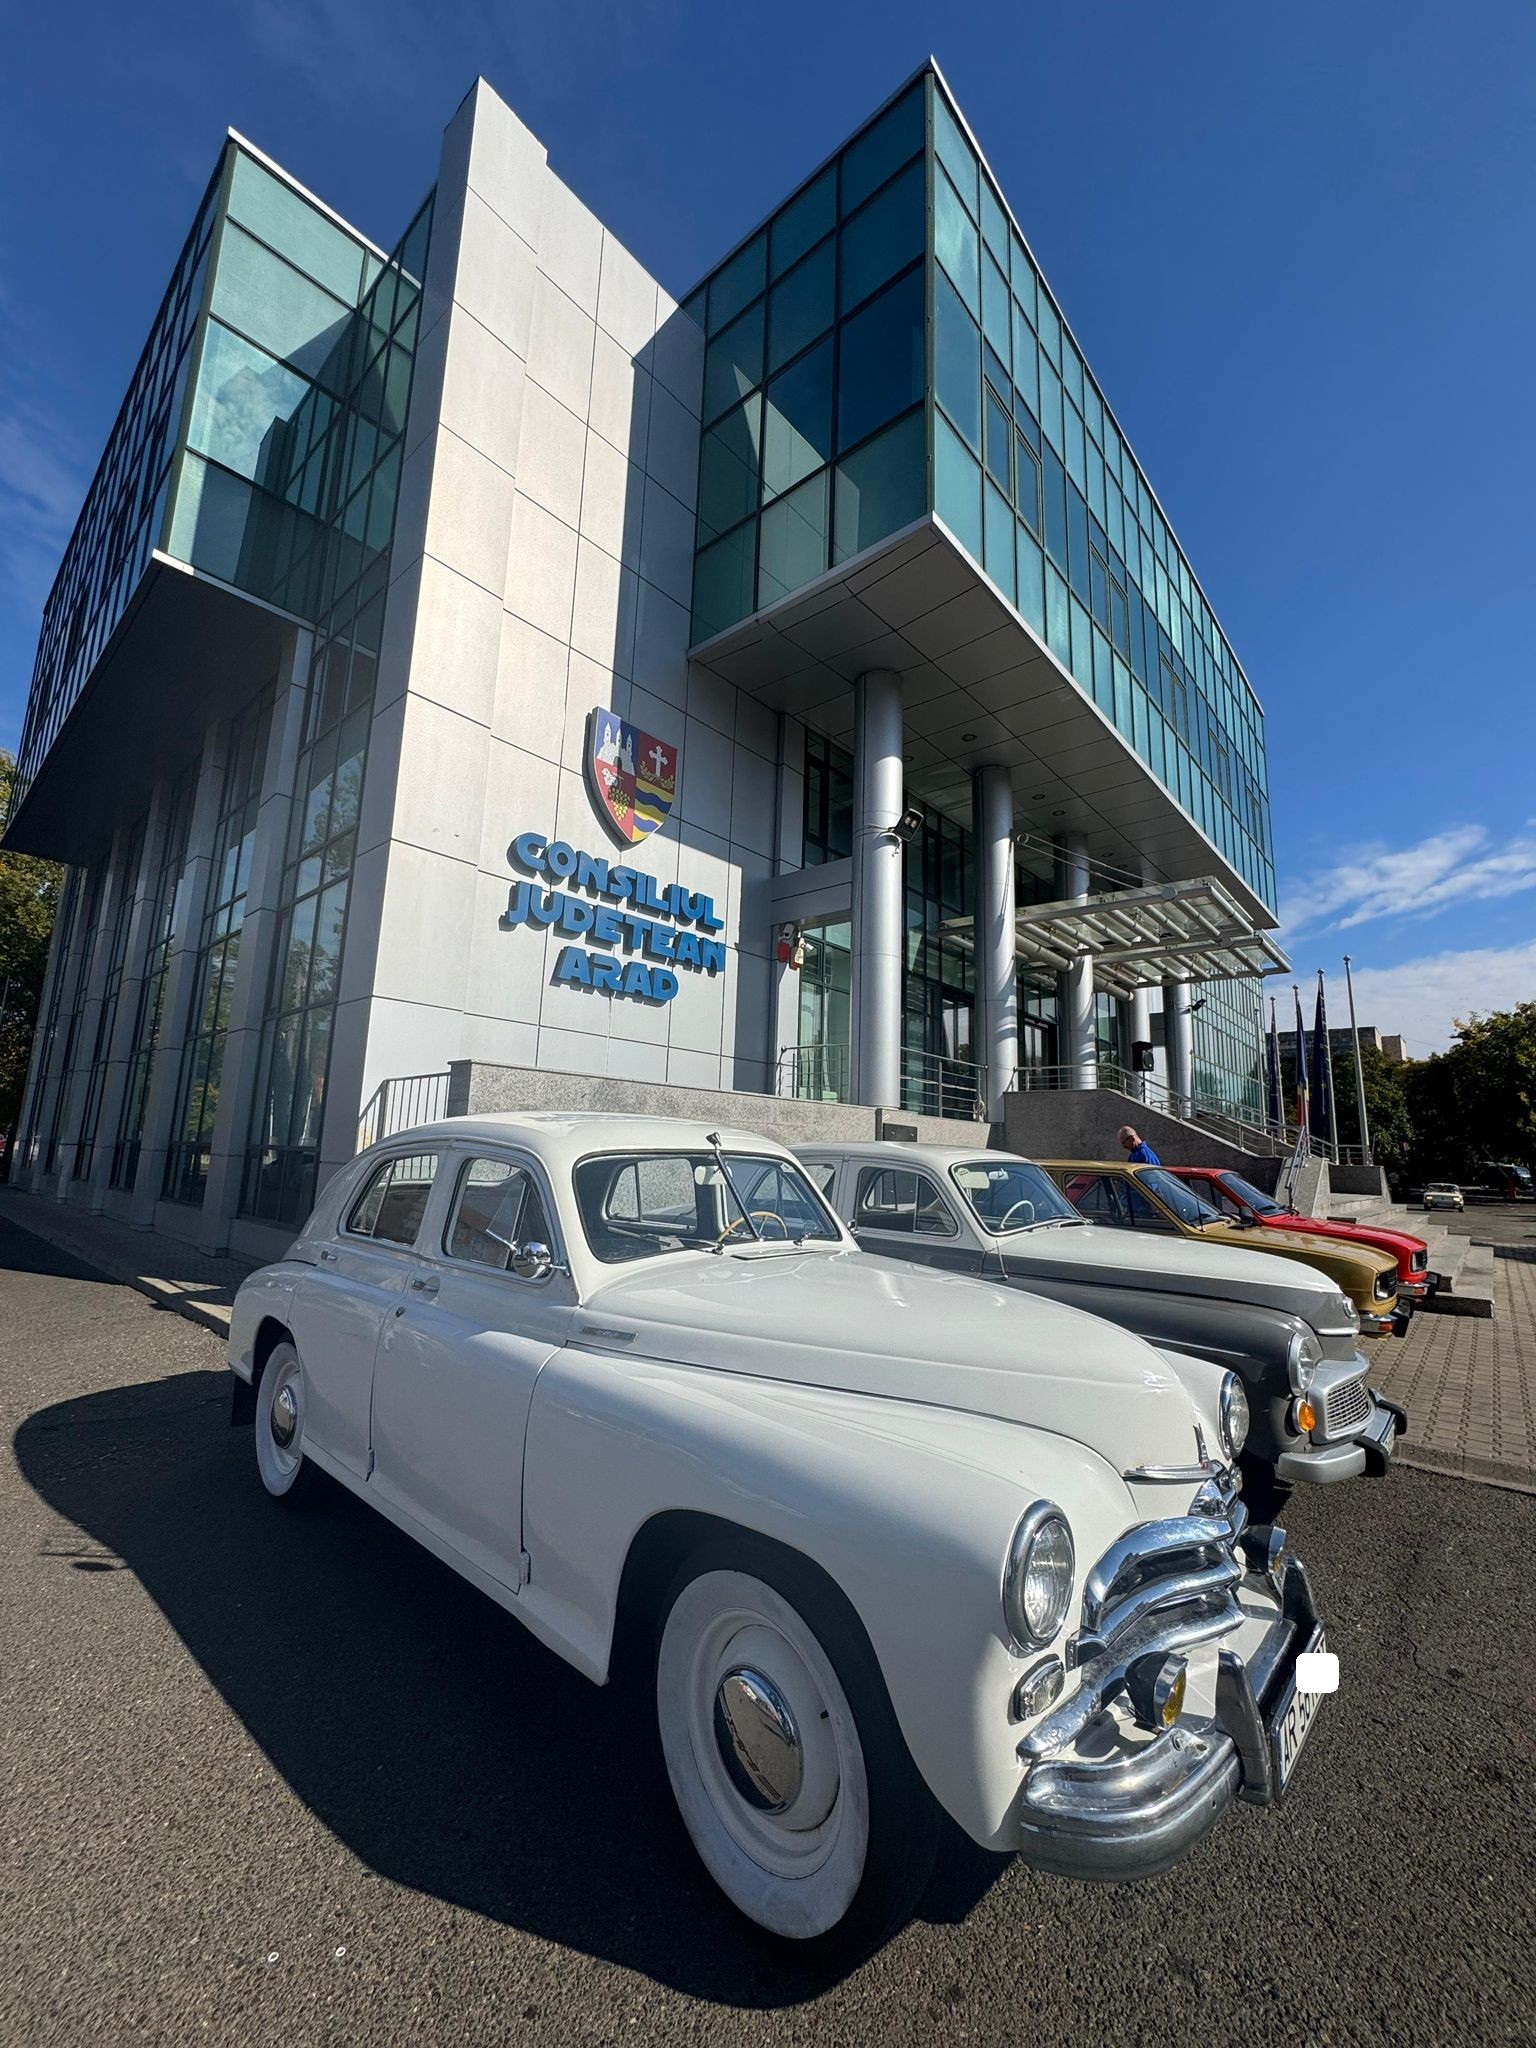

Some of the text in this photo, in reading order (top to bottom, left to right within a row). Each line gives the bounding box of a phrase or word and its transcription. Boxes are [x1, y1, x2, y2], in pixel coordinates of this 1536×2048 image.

[511, 831, 725, 931] CONSILIUL
[554, 945, 680, 1004] ARAD
[1283, 1704, 1298, 1772] AR
